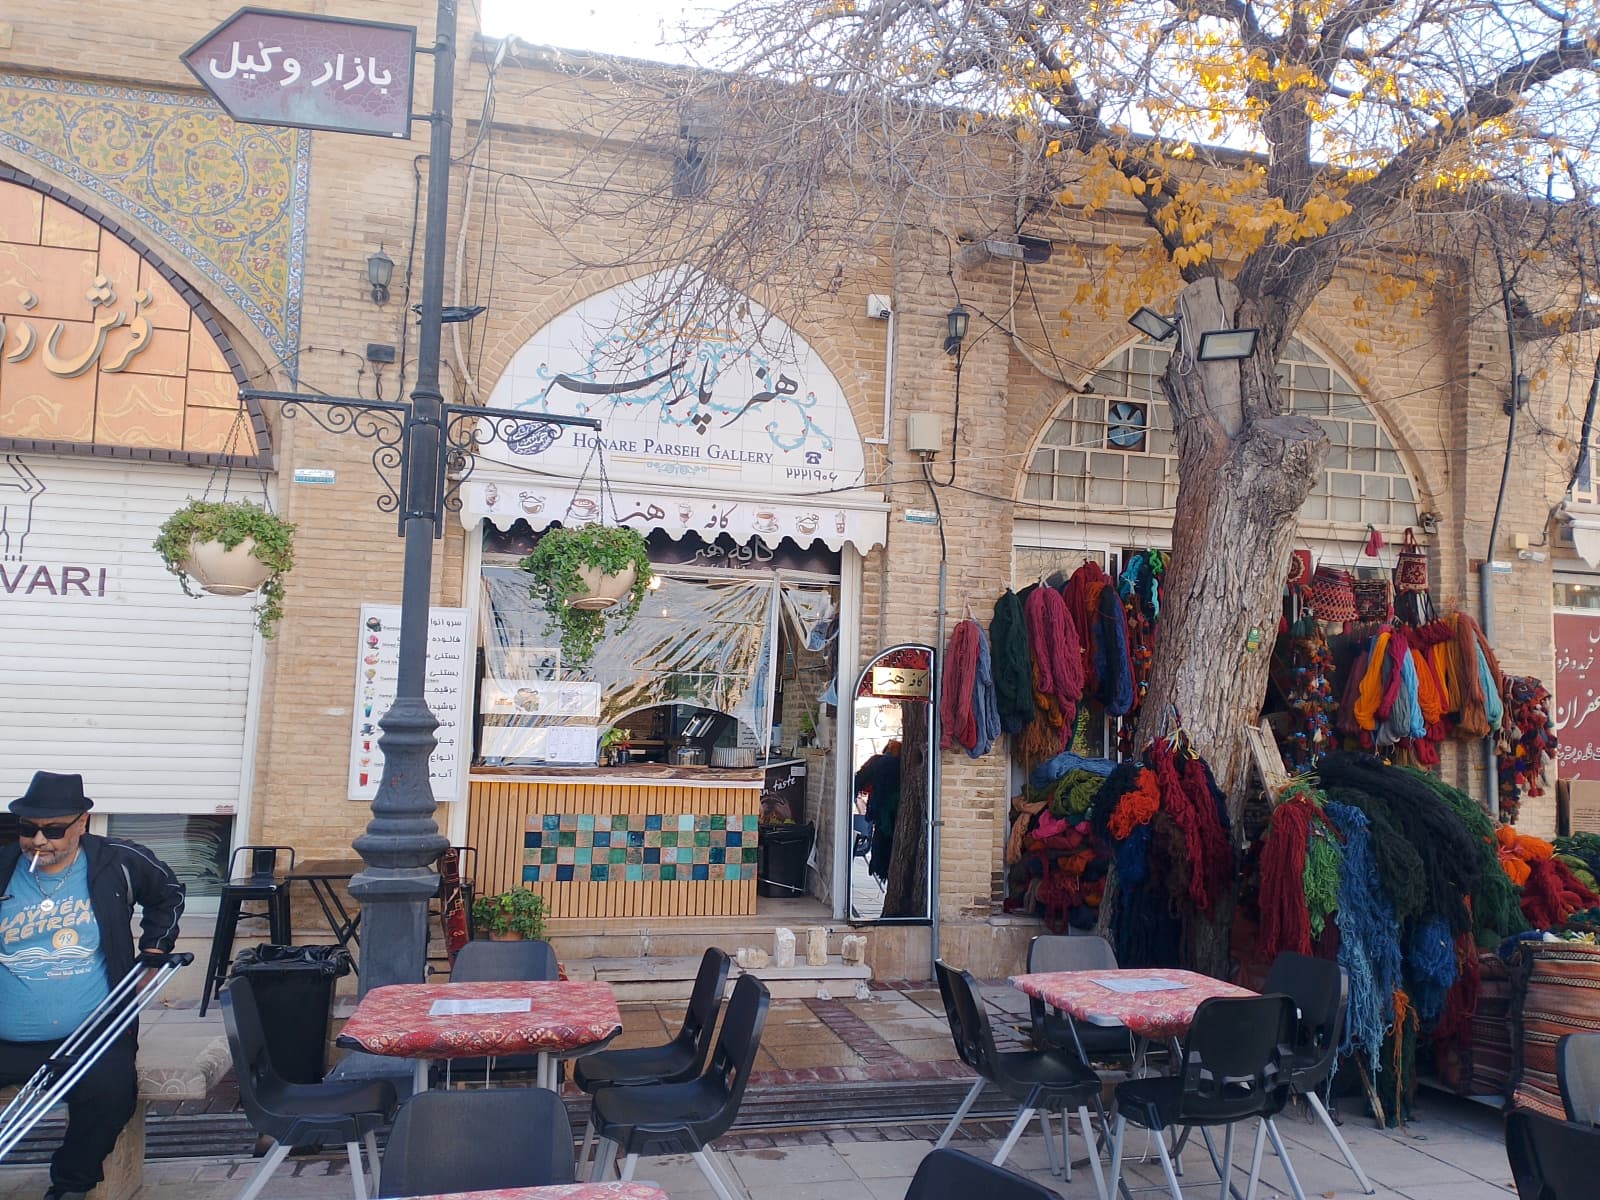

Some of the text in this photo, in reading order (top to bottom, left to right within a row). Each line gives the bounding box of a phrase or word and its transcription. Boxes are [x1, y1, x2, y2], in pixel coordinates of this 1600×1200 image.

[209, 41, 392, 94] بازار وکیل
[42, 275, 152, 379] فرش
[719, 366, 798, 429] هنر
[611, 501, 738, 529] کافه هنر
[0, 563, 107, 598] VARI
[430, 617, 444, 626] انوا
[773, 775, 796, 792] taste
[4, 910, 96, 945] RETREA
